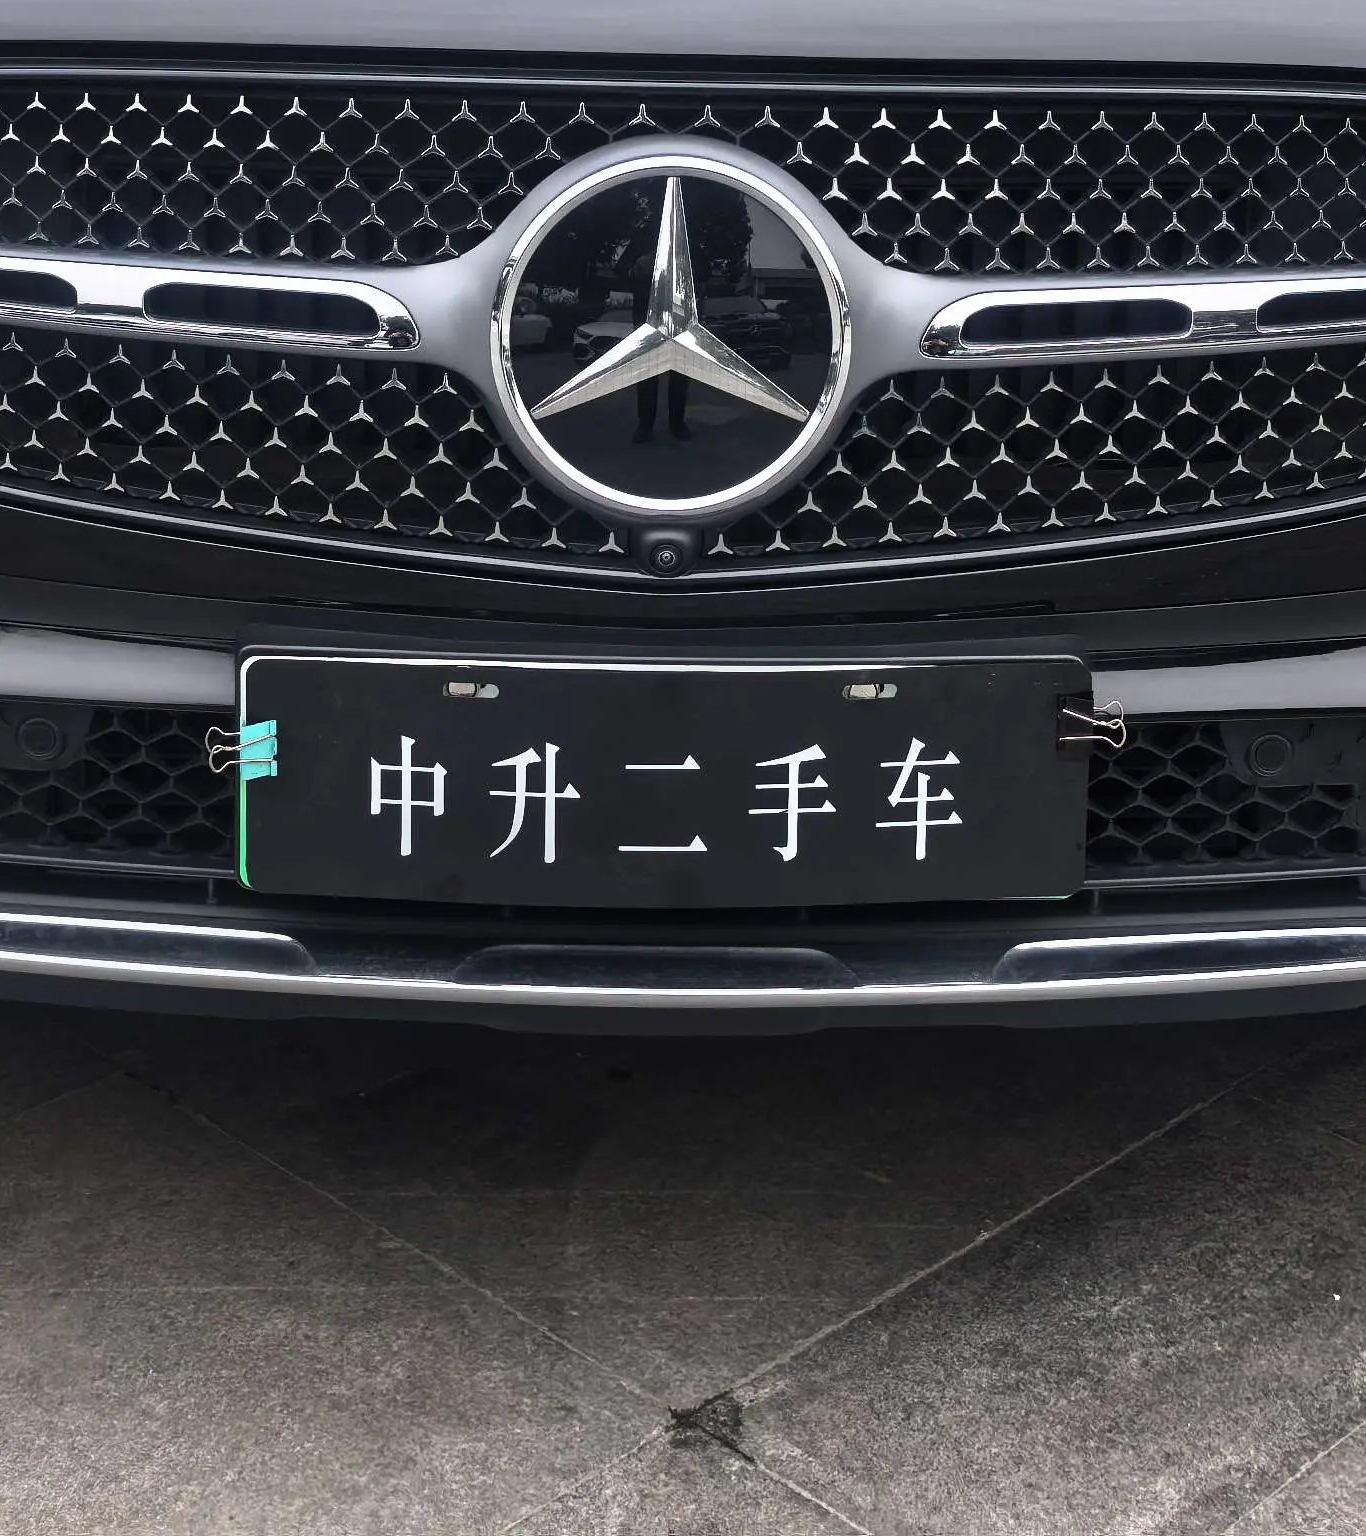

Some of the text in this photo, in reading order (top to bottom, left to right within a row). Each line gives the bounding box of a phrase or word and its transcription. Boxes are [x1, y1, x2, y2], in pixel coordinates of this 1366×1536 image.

[369, 735, 964, 864] 中升二手车
